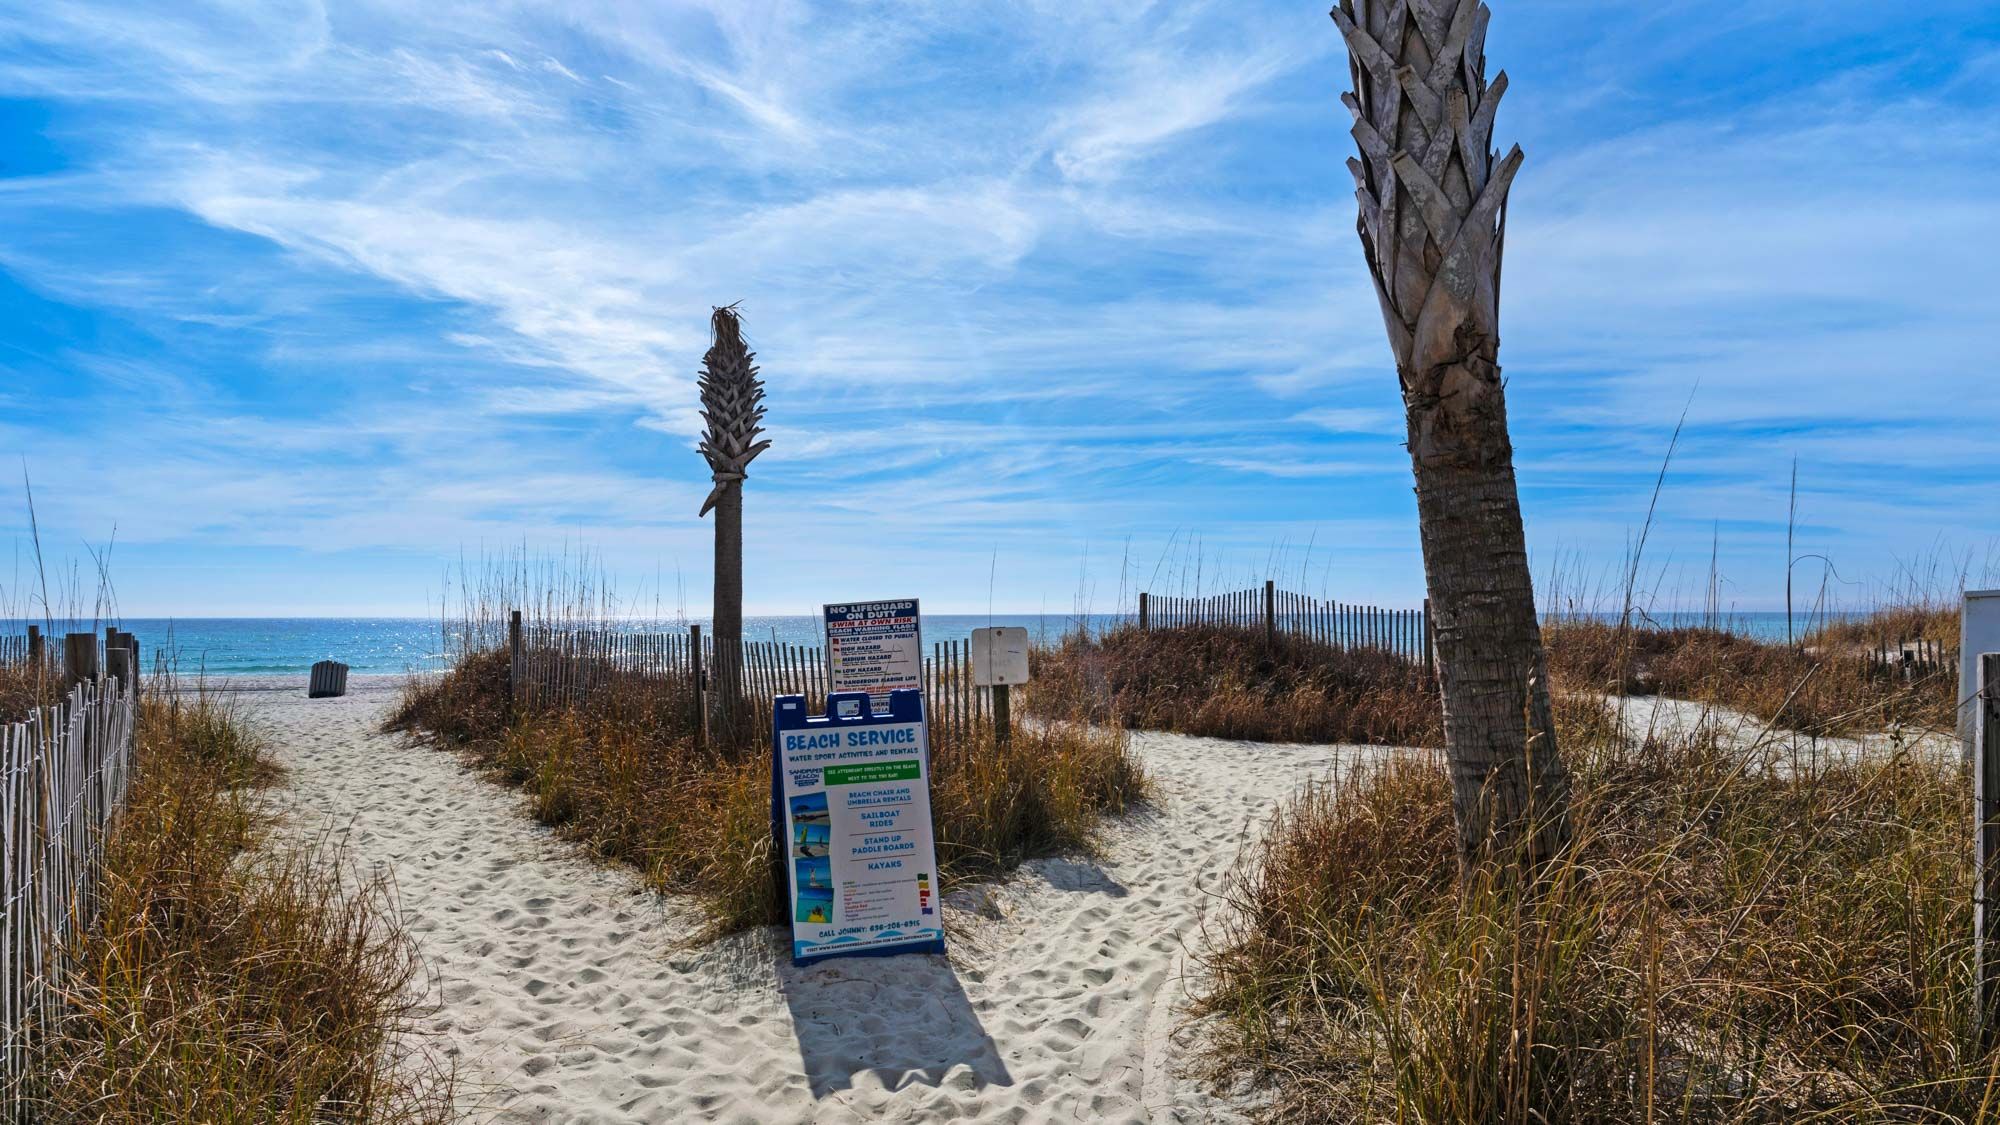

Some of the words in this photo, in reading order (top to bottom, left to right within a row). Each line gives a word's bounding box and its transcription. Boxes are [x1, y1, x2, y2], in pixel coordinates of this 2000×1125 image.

[830, 606, 847, 614] NO
[851, 602, 912, 613] LIFEGUARD
[868, 610, 897, 618] DUTY
[786, 732, 840, 751] BEACH
[848, 728, 915, 747] SERVICE
[789, 754, 812, 762] WATER
[814, 752, 836, 761] SPORT
[838, 750, 873, 759] ACTIVITIES
[890, 747, 918, 755] RENTALS
[849, 791, 871, 799] BEACH
[847, 798, 881, 806] UMBRELLA
[882, 795, 911, 803] RENTALS
[861, 810, 900, 820] SAILBOAT
[869, 820, 893, 828] RIDES
[864, 836, 889, 845] STAND
[852, 845, 882, 855] PADDLE
[883, 842, 914, 851] BOARDS
[868, 861, 902, 870] KAYAKS
[818, 930, 836, 938] CALL
